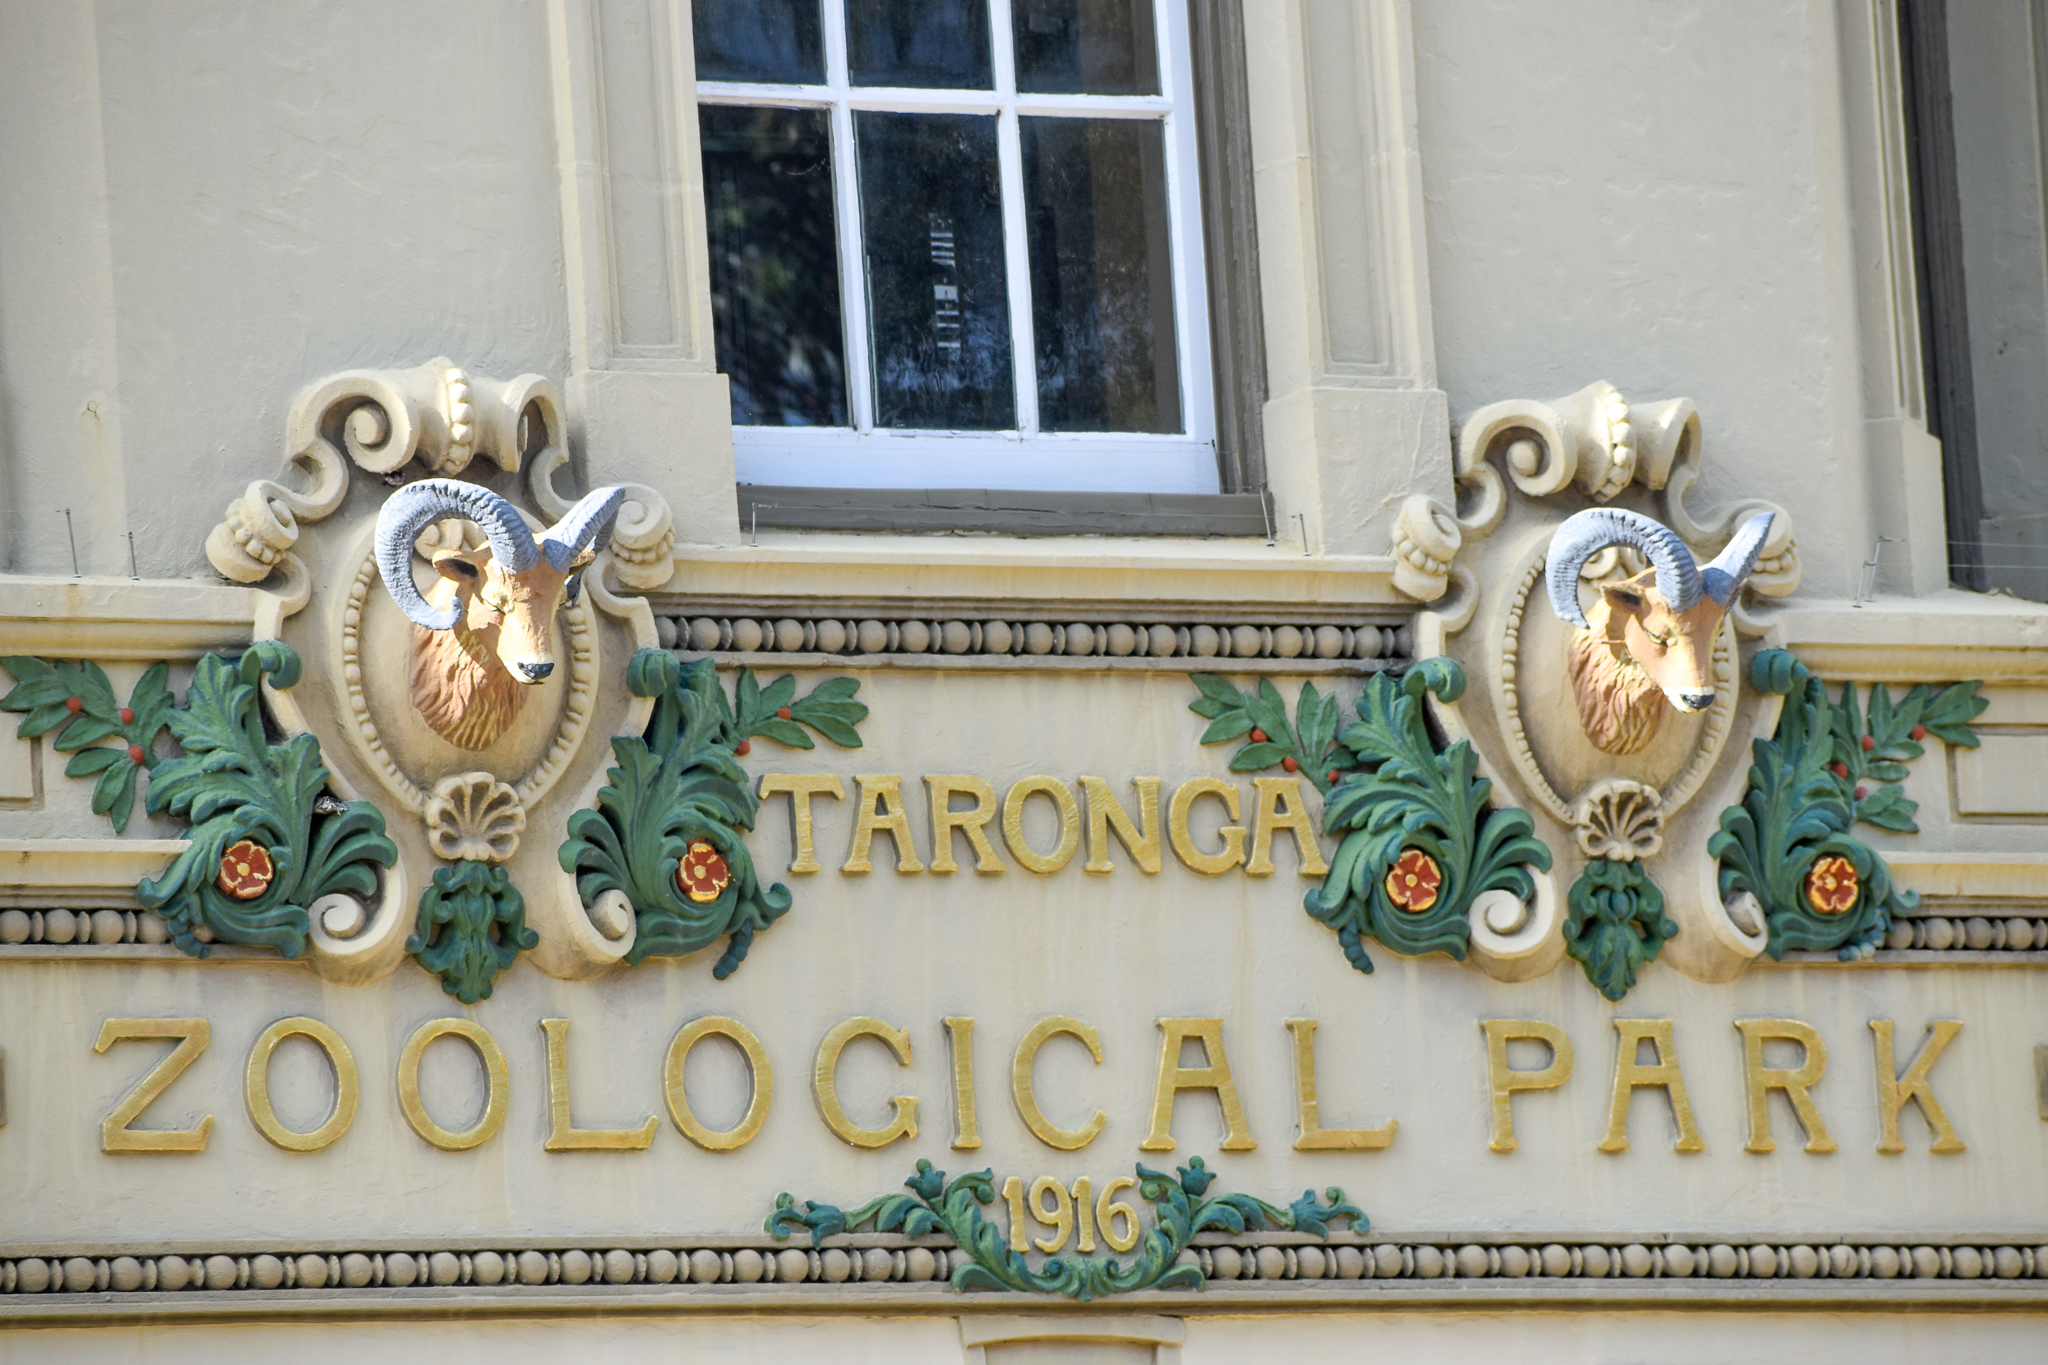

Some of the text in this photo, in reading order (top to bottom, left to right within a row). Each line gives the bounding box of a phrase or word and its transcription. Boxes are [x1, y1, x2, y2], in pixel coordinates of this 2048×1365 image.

[758, 773, 1329, 875] TARONGA
[94, 1016, 1967, 1155] ZOOLOGICAL PARK
[1002, 1175, 1140, 1253] 1916
